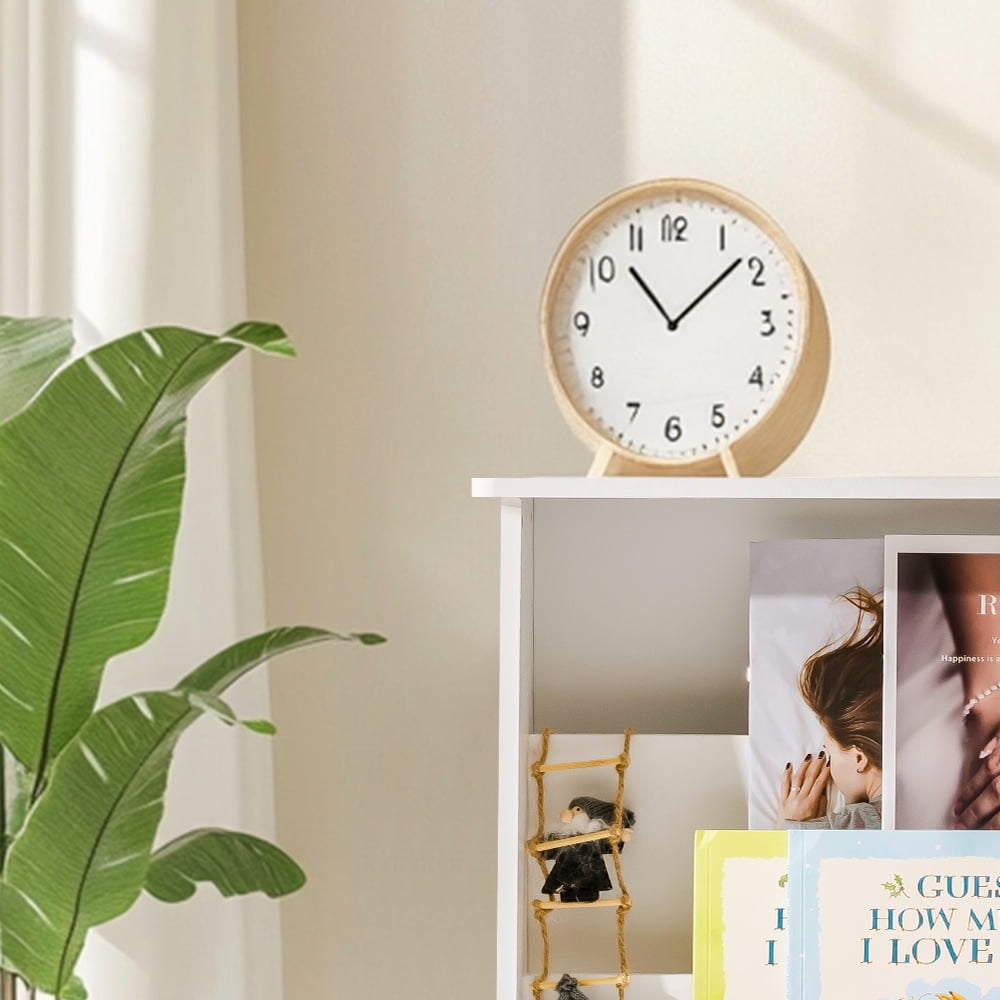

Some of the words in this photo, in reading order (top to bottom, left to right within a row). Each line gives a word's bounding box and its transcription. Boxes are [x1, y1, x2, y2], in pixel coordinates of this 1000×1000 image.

[629, 223, 643, 252] 11
[719, 224, 726, 251] 1
[588, 255, 616, 292] 10
[747, 256, 766, 287] 2
[573, 311, 590, 337] 9
[759, 309, 776, 337] 3
[591, 366, 605, 389] 8
[748, 364, 765, 391] 4
[626, 402, 641, 423] 7
[711, 403, 726, 428] 5
[664, 416, 682, 442] 6
[940, 654, 985, 664] Happiness
[986, 654, 995, 662] is
[869, 907, 958, 932] HOW
[860, 937, 873, 964] I
[888, 937, 994, 966] LOVE
